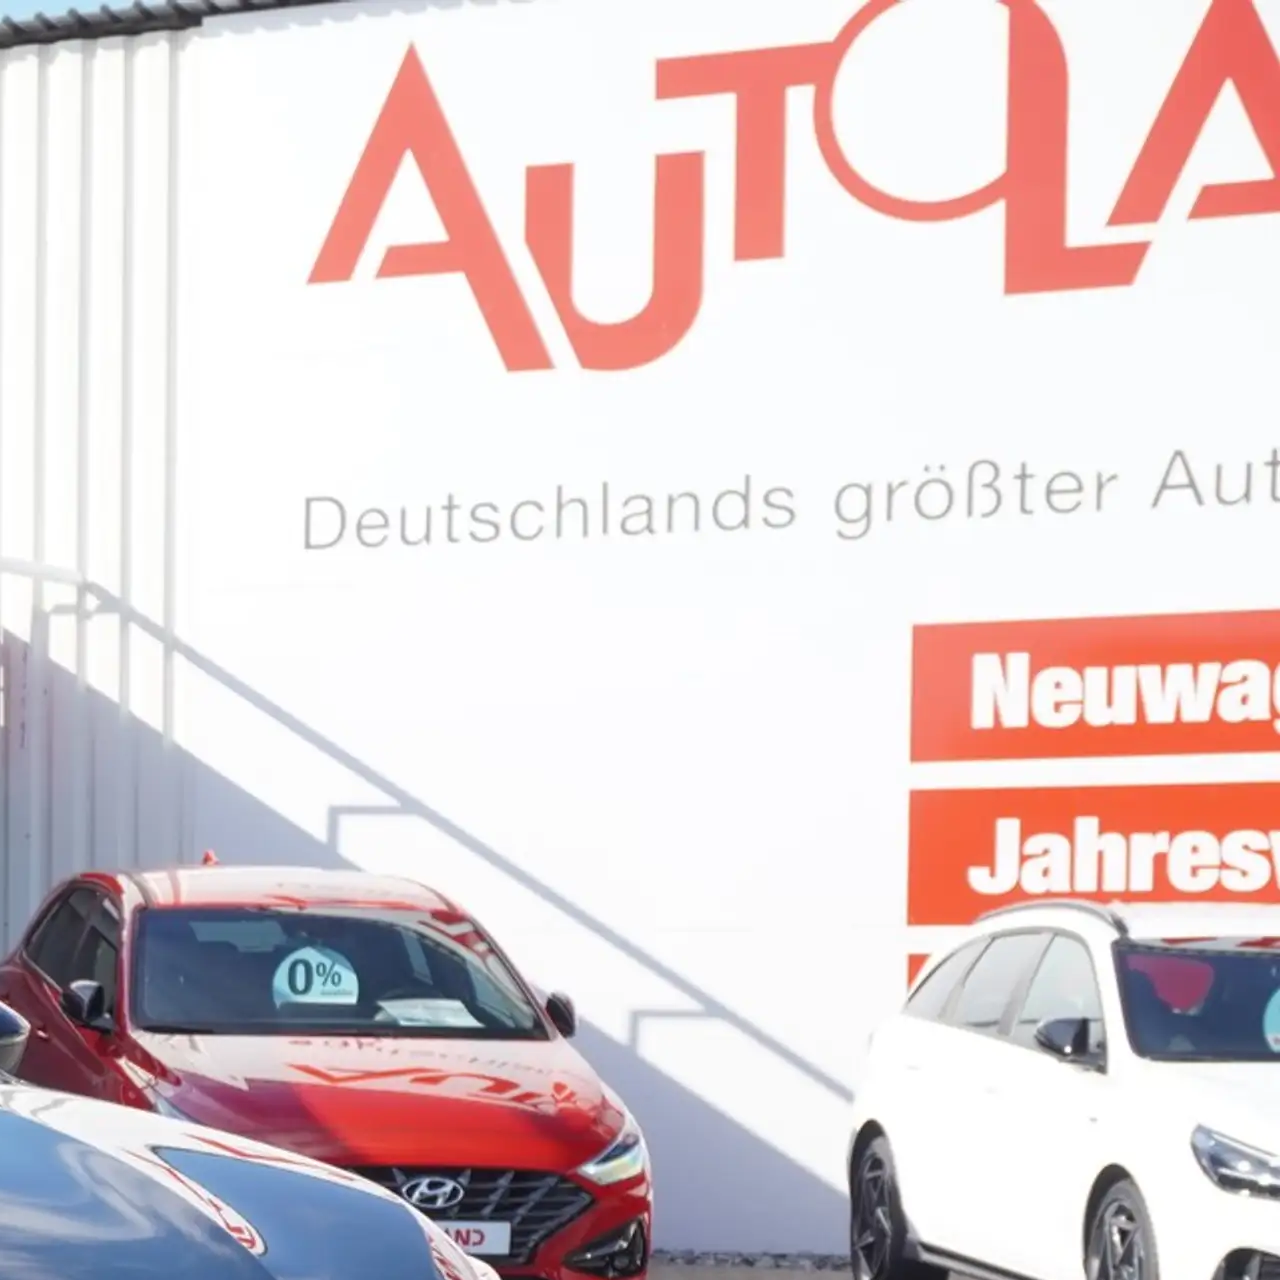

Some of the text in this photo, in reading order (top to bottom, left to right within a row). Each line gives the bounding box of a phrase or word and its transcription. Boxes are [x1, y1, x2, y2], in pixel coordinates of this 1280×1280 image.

[303, 447, 1280, 550] Deutschlands größter Aut
[971, 652, 1280, 736] Neuwa
[967, 816, 1280, 896] Jahres
[287, 958, 342, 996] 0%
